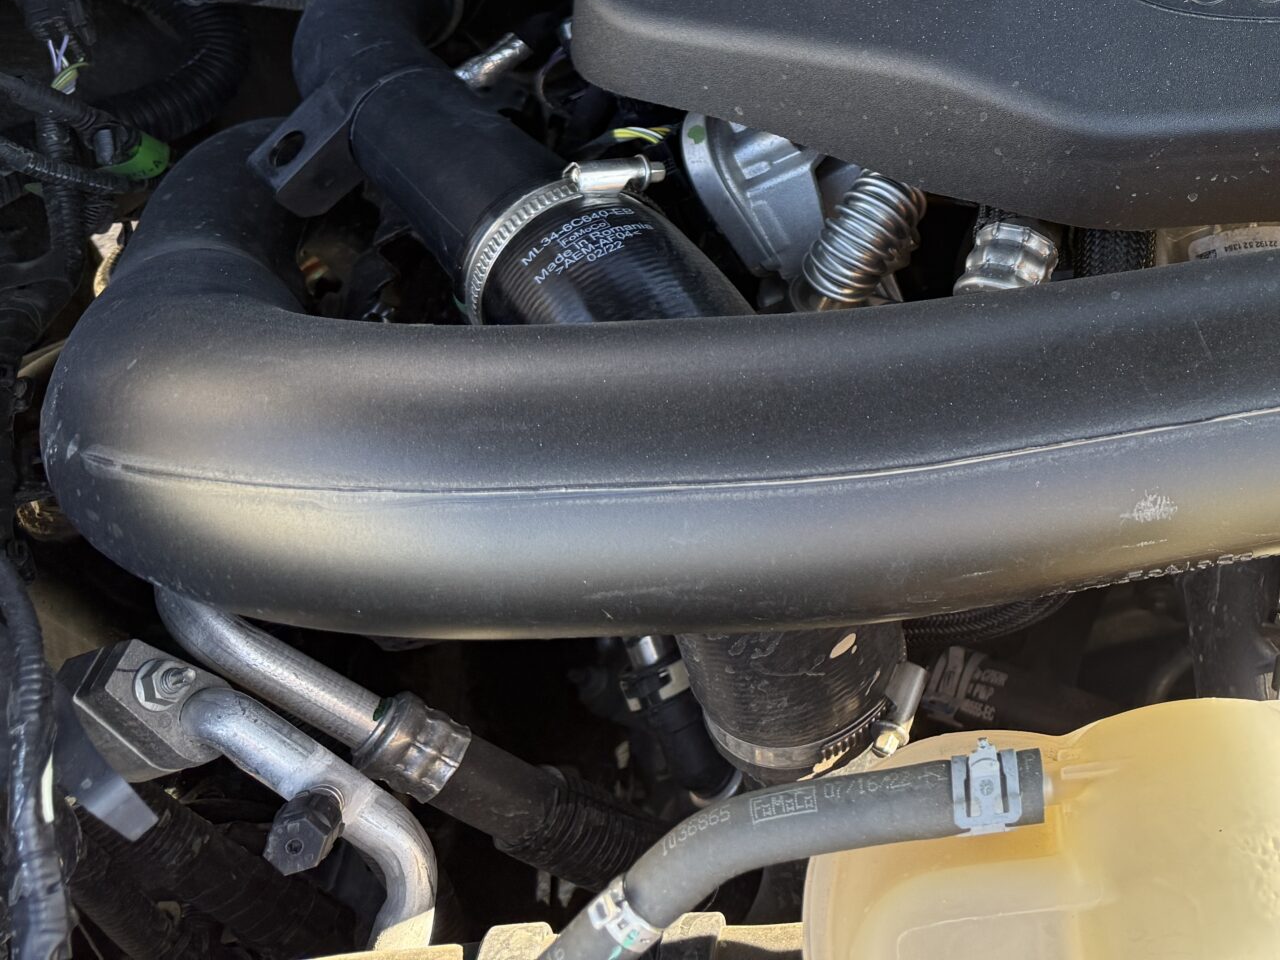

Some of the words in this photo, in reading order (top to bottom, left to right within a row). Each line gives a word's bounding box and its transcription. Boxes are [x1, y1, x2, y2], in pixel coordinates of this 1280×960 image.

[521, 207, 636, 266] ML34-6C640-EB
[561, 221, 606, 246] FoMoCo
[534, 250, 574, 284] Made
[574, 237, 588, 250] in
[590, 223, 654, 241] Romania
[586, 242, 625, 263] 02/22
[752, 790, 816, 821] FoMoCo
